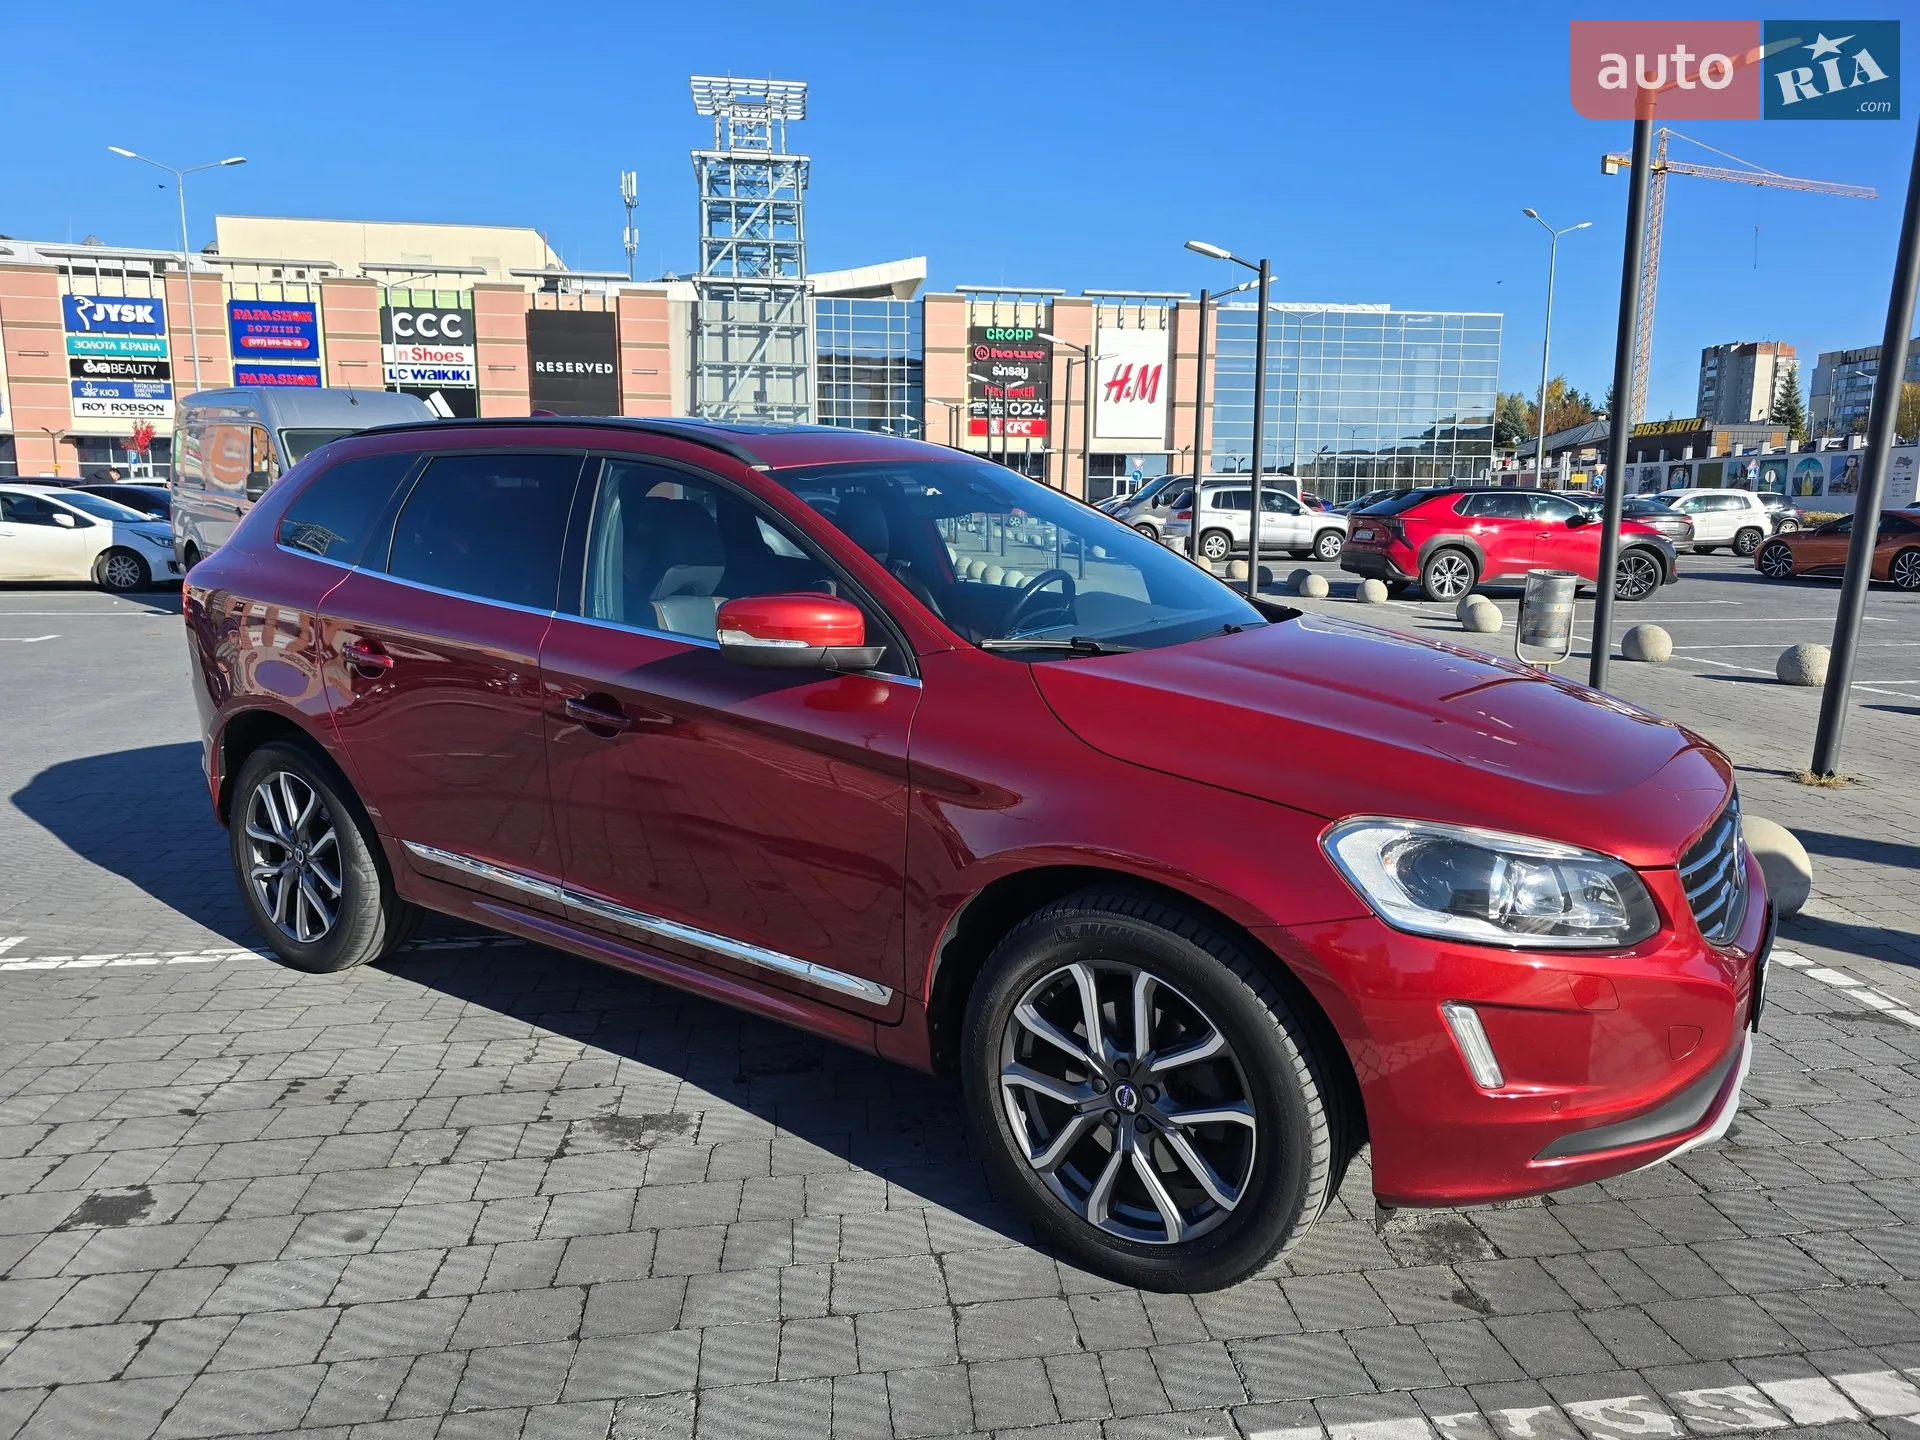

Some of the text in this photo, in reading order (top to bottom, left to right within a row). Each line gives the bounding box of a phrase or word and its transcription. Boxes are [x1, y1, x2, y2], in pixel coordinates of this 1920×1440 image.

[92, 303, 156, 323] JYSK
[393, 312, 463, 338] CCC
[986, 328, 1034, 341] CROPP
[73, 340, 117, 350] ЗОЛОТА
[411, 347, 464, 363] Shoes
[388, 368, 408, 380] LC
[535, 361, 613, 374] RESERVED
[992, 364, 1028, 379] sinsay
[1103, 363, 1162, 404] H&M
[82, 403, 165, 412] ROY ROBSON
[1006, 402, 1046, 416] 024
[1634, 418, 1703, 436] BOSS AUTO
